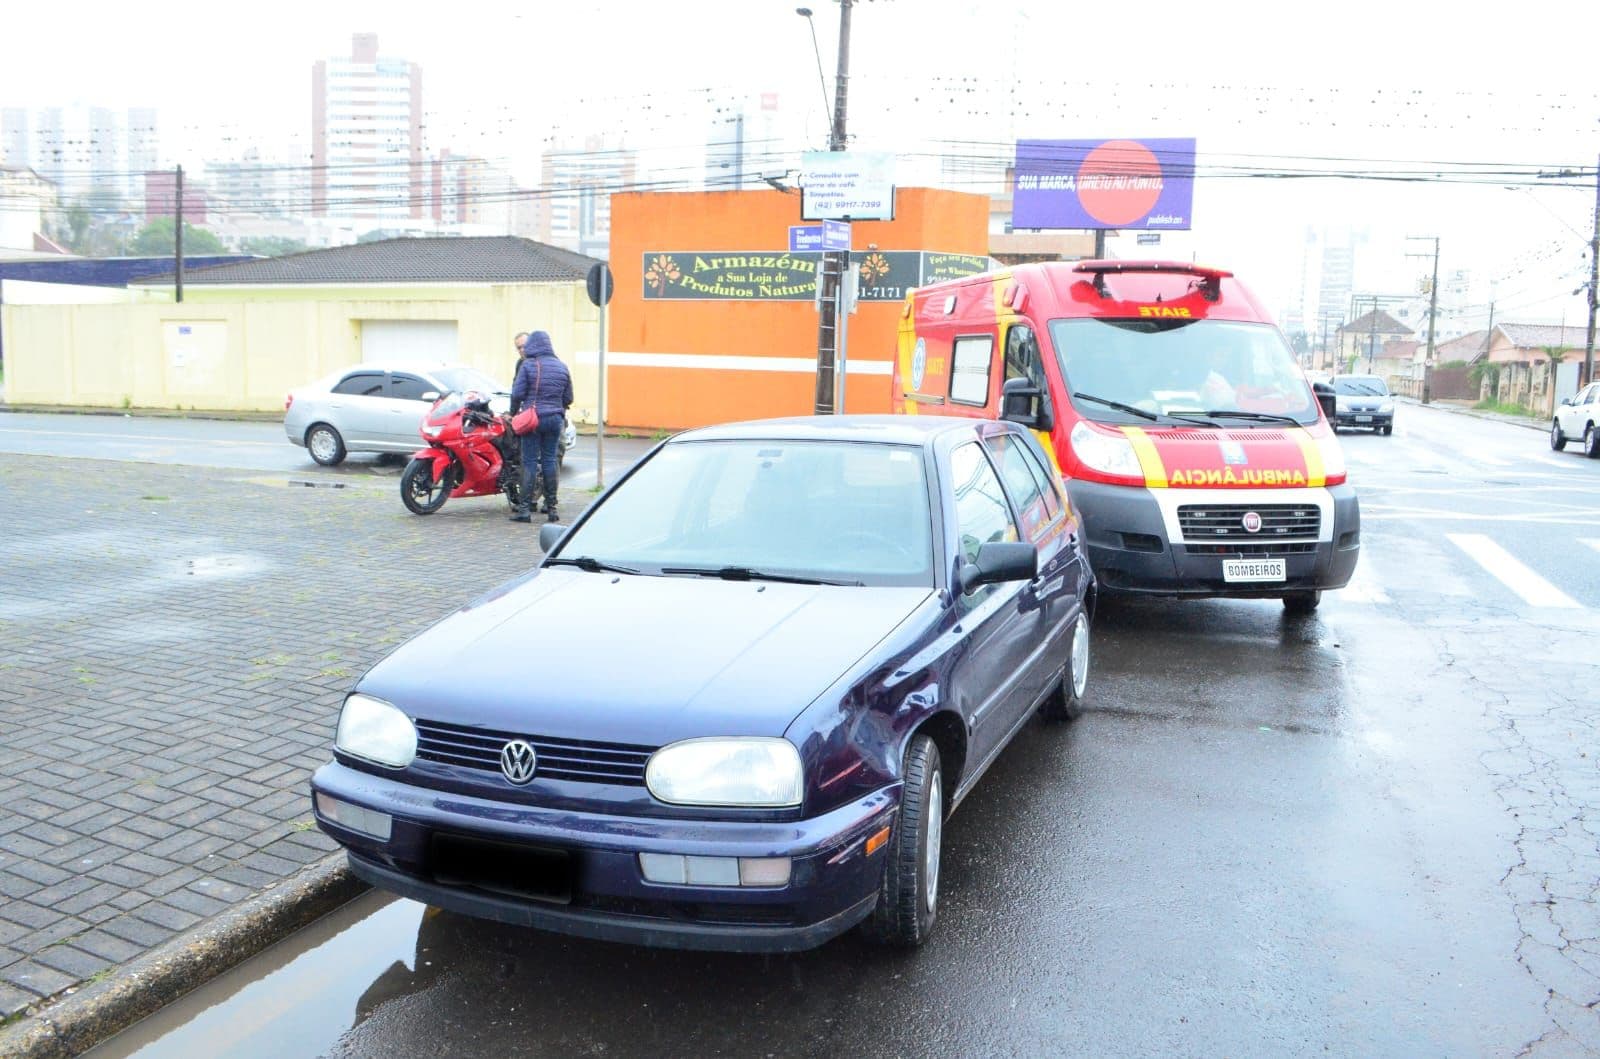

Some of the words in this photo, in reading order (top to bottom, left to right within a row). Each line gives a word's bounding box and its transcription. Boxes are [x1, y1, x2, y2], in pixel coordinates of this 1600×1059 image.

[1017, 175, 1037, 190] SUA
[1039, 175, 1075, 192] MARCA,
[814, 201, 832, 210] (42)
[693, 253, 815, 273] Armazém
[718, 274, 724, 283] a
[726, 272, 747, 283] Sua
[749, 272, 772, 283] Loja
[775, 271, 788, 283] de
[680, 275, 754, 297] Produtos
[1228, 564, 1282, 576] BOMBEIROS
